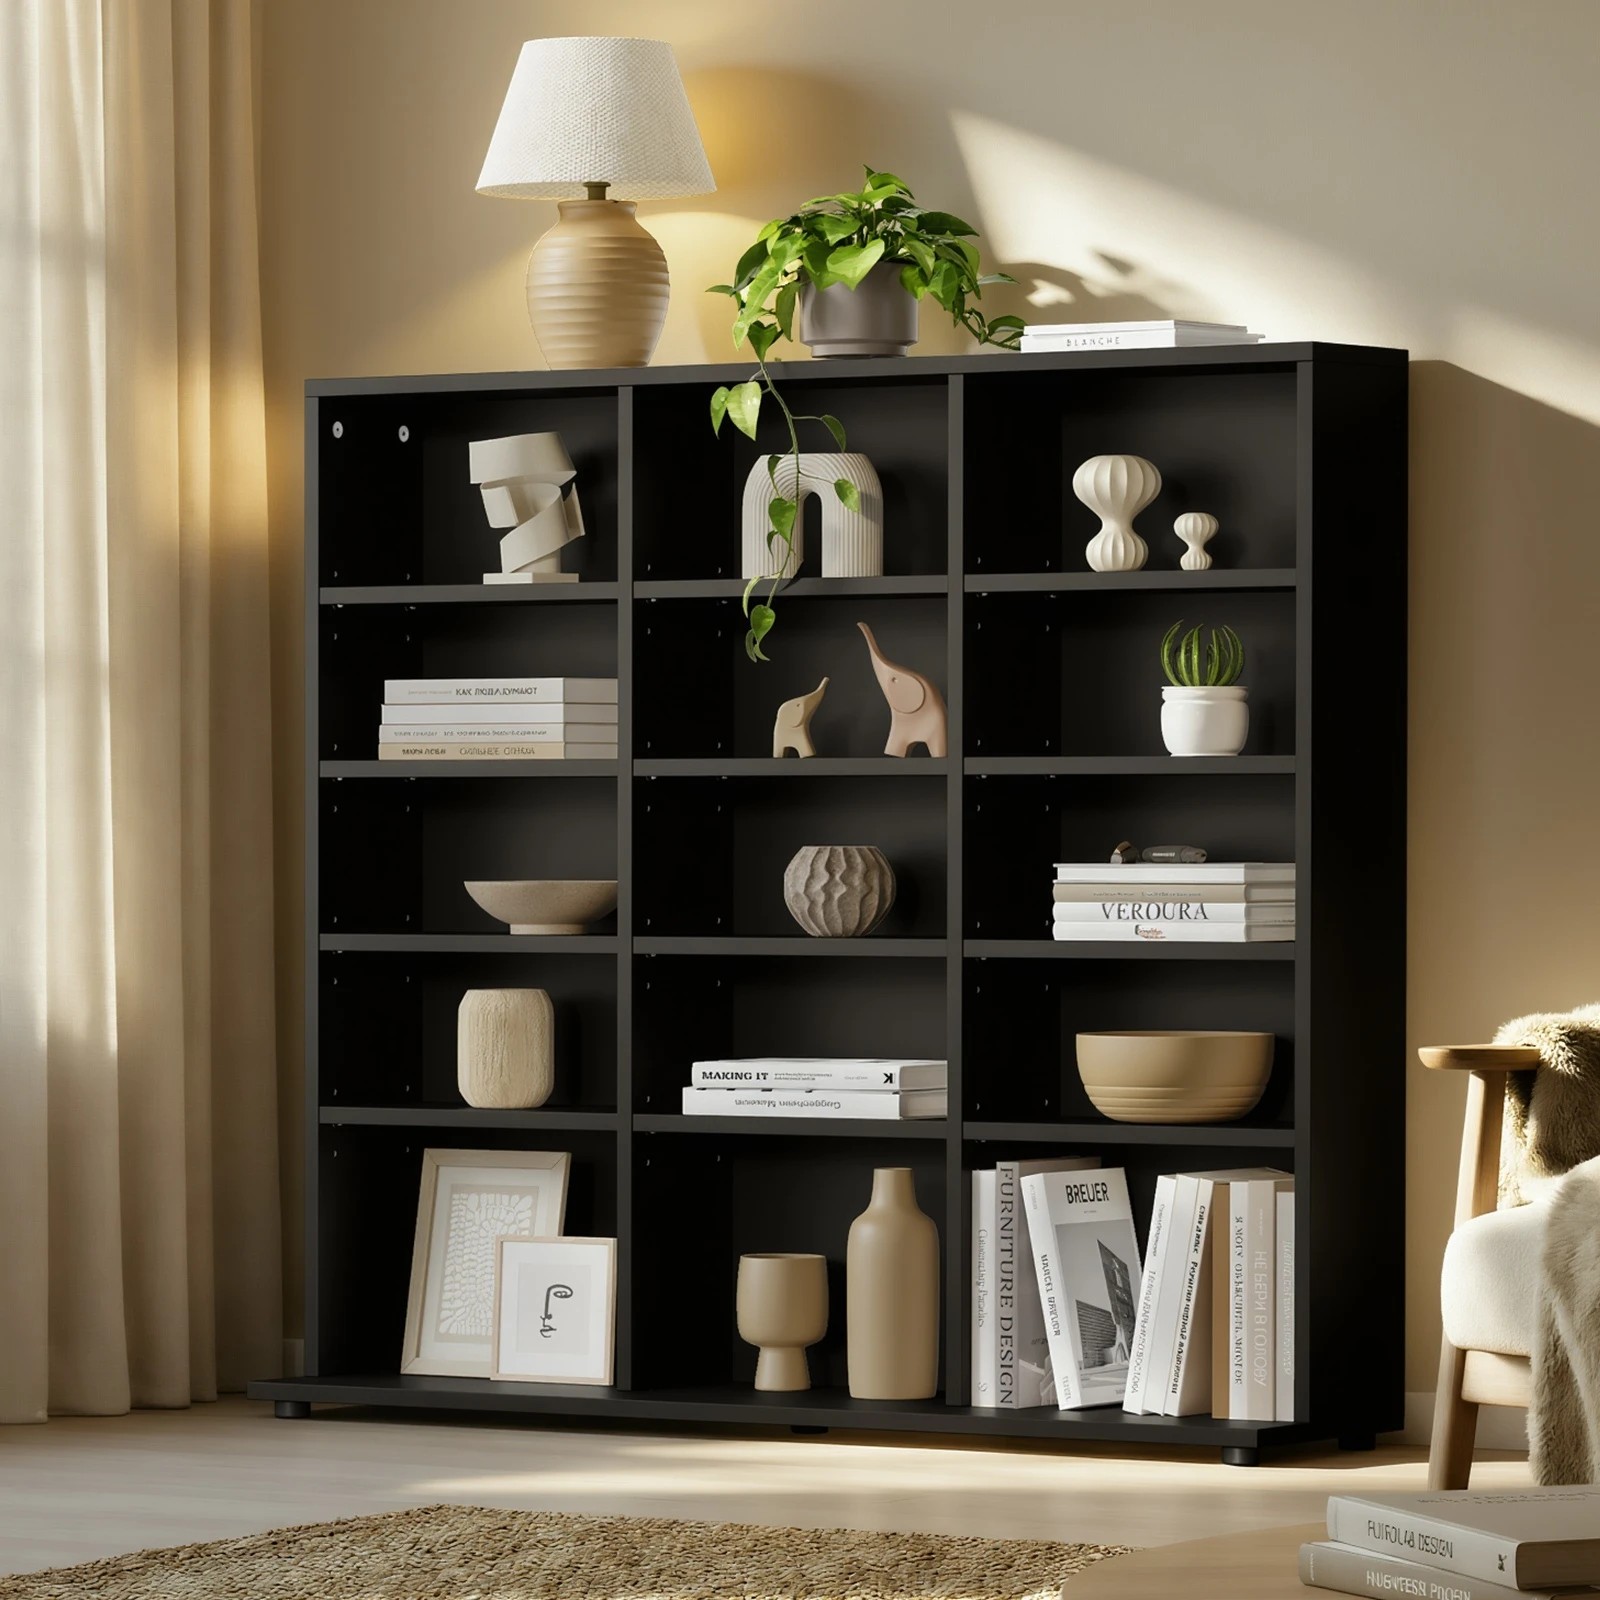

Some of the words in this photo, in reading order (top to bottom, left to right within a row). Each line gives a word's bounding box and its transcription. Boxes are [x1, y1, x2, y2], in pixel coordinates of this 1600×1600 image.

[1066, 336, 1121, 347] BLANCHE
[1101, 902, 1209, 920] VEROURA
[701, 1071, 753, 1081] MAKING
[755, 1071, 769, 1081] IT
[1065, 1182, 1110, 1204] BREUER
[999, 1166, 1014, 1309] FURNITURE
[1254, 1250, 1267, 1270] НЕ
[999, 1316, 1014, 1405] DESIGN
